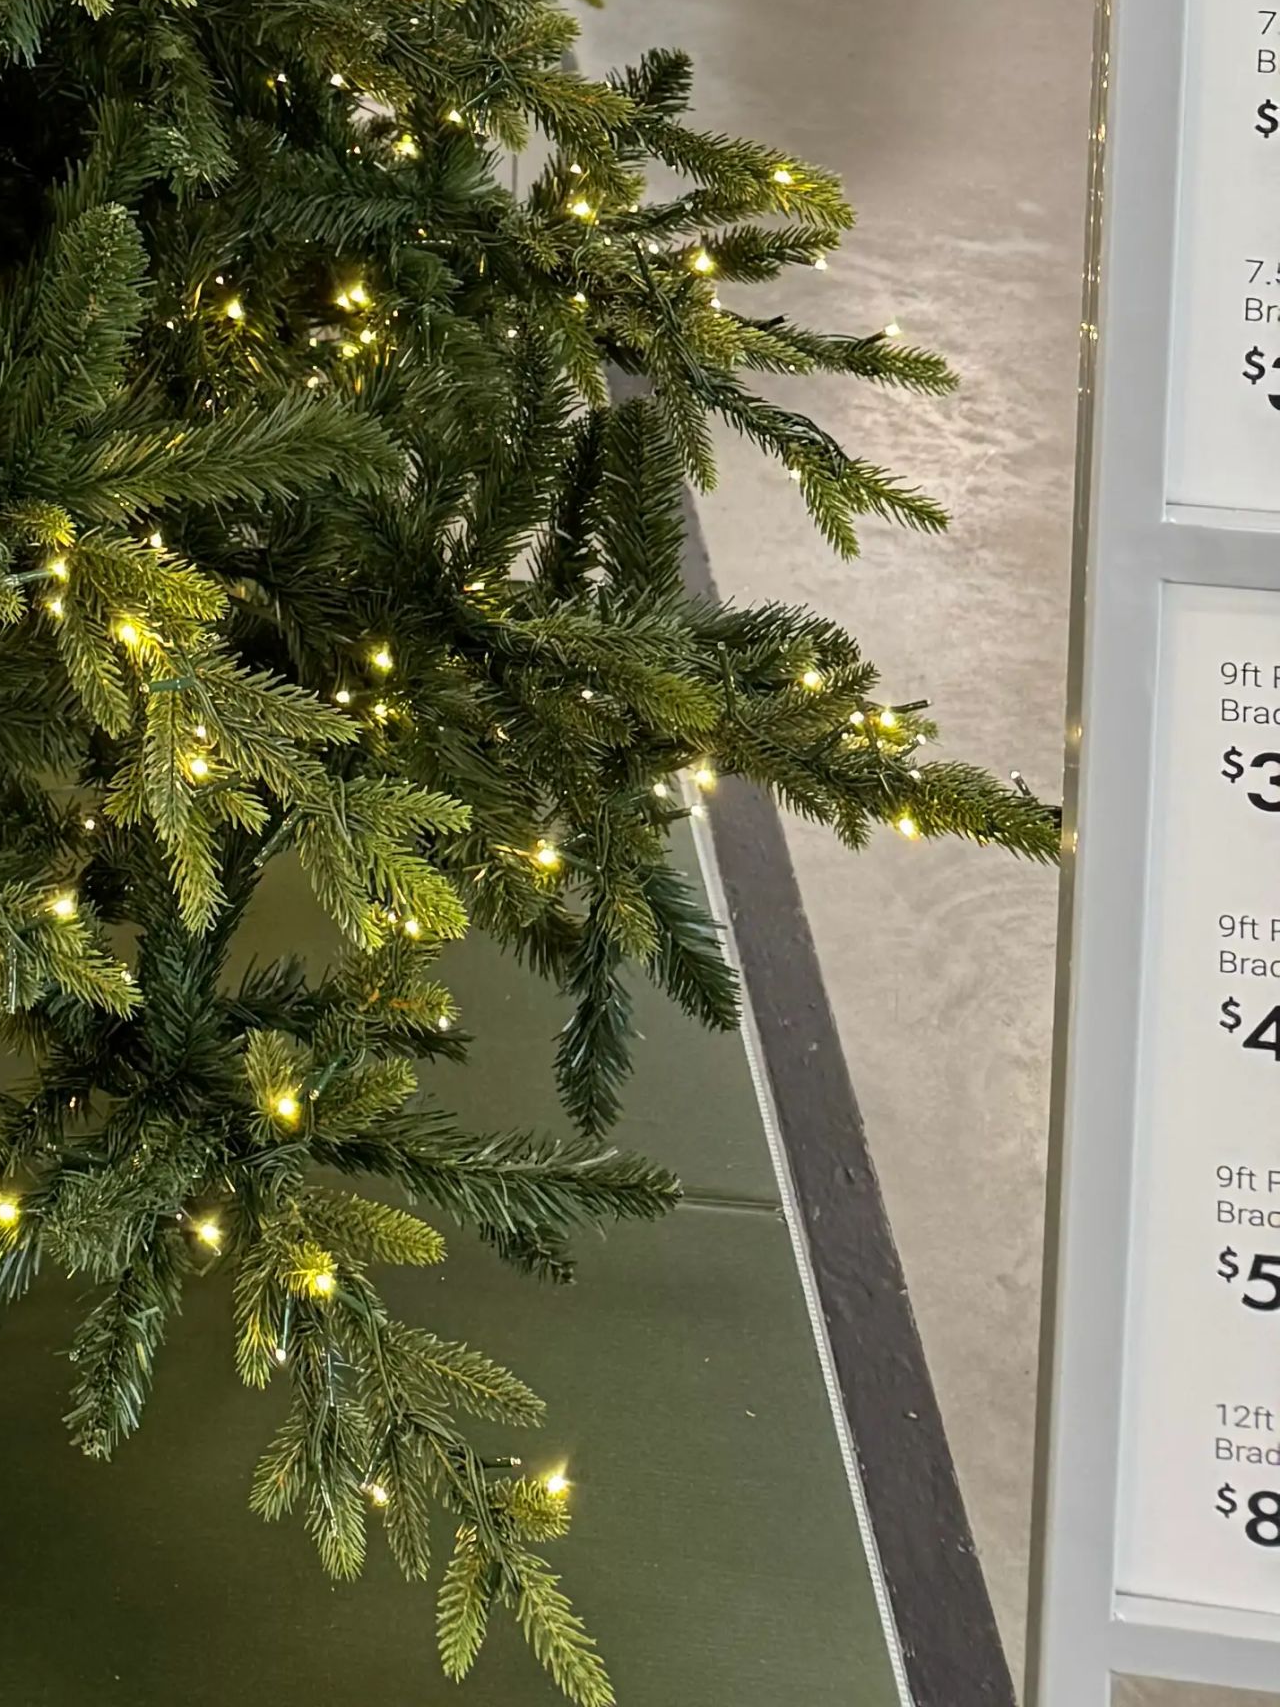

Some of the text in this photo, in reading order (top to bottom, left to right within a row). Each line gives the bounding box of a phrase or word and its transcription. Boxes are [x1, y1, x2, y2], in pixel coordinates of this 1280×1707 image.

[1221, 662, 1262, 687] 9ft
[1219, 915, 1259, 940] 9ft
[1216, 1165, 1257, 1192] 9ft
[1216, 1404, 1275, 1431] 12ft
